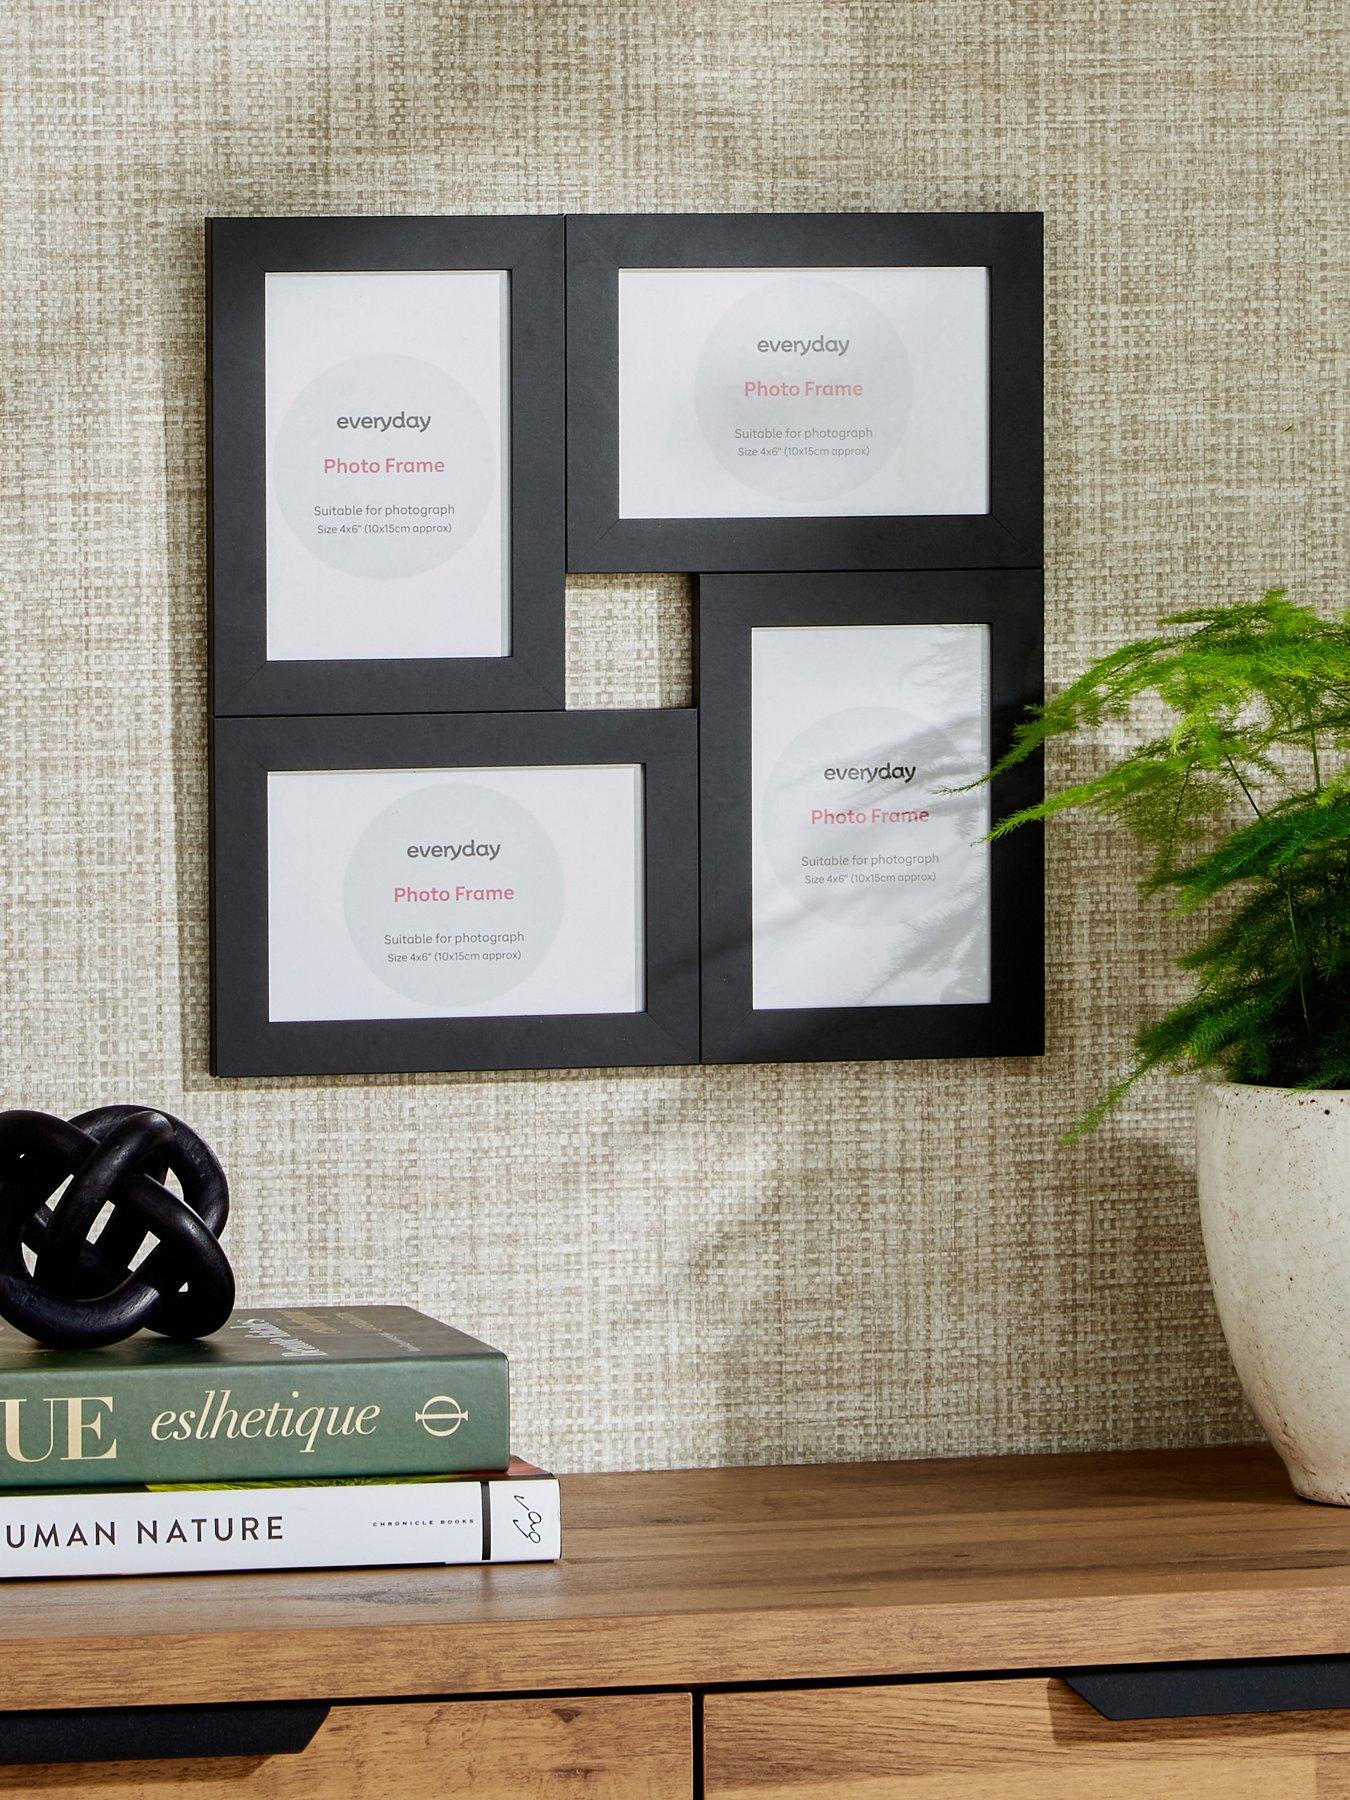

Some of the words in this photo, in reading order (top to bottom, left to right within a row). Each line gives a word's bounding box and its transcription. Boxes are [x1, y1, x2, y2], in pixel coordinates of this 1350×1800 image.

[757, 335, 850, 357] everyday
[744, 381, 800, 397] Photo
[805, 381, 863, 396] Frame
[337, 411, 432, 432] everyday
[734, 428, 783, 439] Suitable
[785, 428, 802, 439] for
[804, 427, 873, 440] photograph
[738, 447, 758, 456] Size
[784, 446, 829, 457] (10x15cm
[832, 446, 870, 458] approx)
[324, 458, 380, 474] Photo
[386, 457, 445, 473] Frame
[314, 505, 363, 516] Suitable
[366, 504, 382, 515] for
[385, 504, 455, 518] photograph
[317, 524, 337, 534] Size
[364, 524, 411, 535] (10x15cm
[412, 523, 452, 535] approx)
[824, 762, 916, 783] everyday
[811, 809, 867, 825] Photo
[871, 808, 930, 824] Frame
[407, 839, 501, 861] everyday
[801, 855, 849, 867] Suitable
[851, 855, 867, 866] for
[870, 853, 939, 867] photograph
[805, 875, 824, 885] Size
[850, 873, 896, 884] (10x15cm
[898, 872, 937, 884] approx)
[394, 887, 450, 903] Photo
[455, 886, 514, 901] Frame
[384, 933, 433, 945] Suitable
[435, 933, 452, 944] for
[454, 931, 525, 945] photograph
[387, 953, 408, 963] Size
[434, 951, 480, 962] (10x15cm
[482, 950, 522, 962] approx)
[137, 1515, 284, 1544] NATURE
